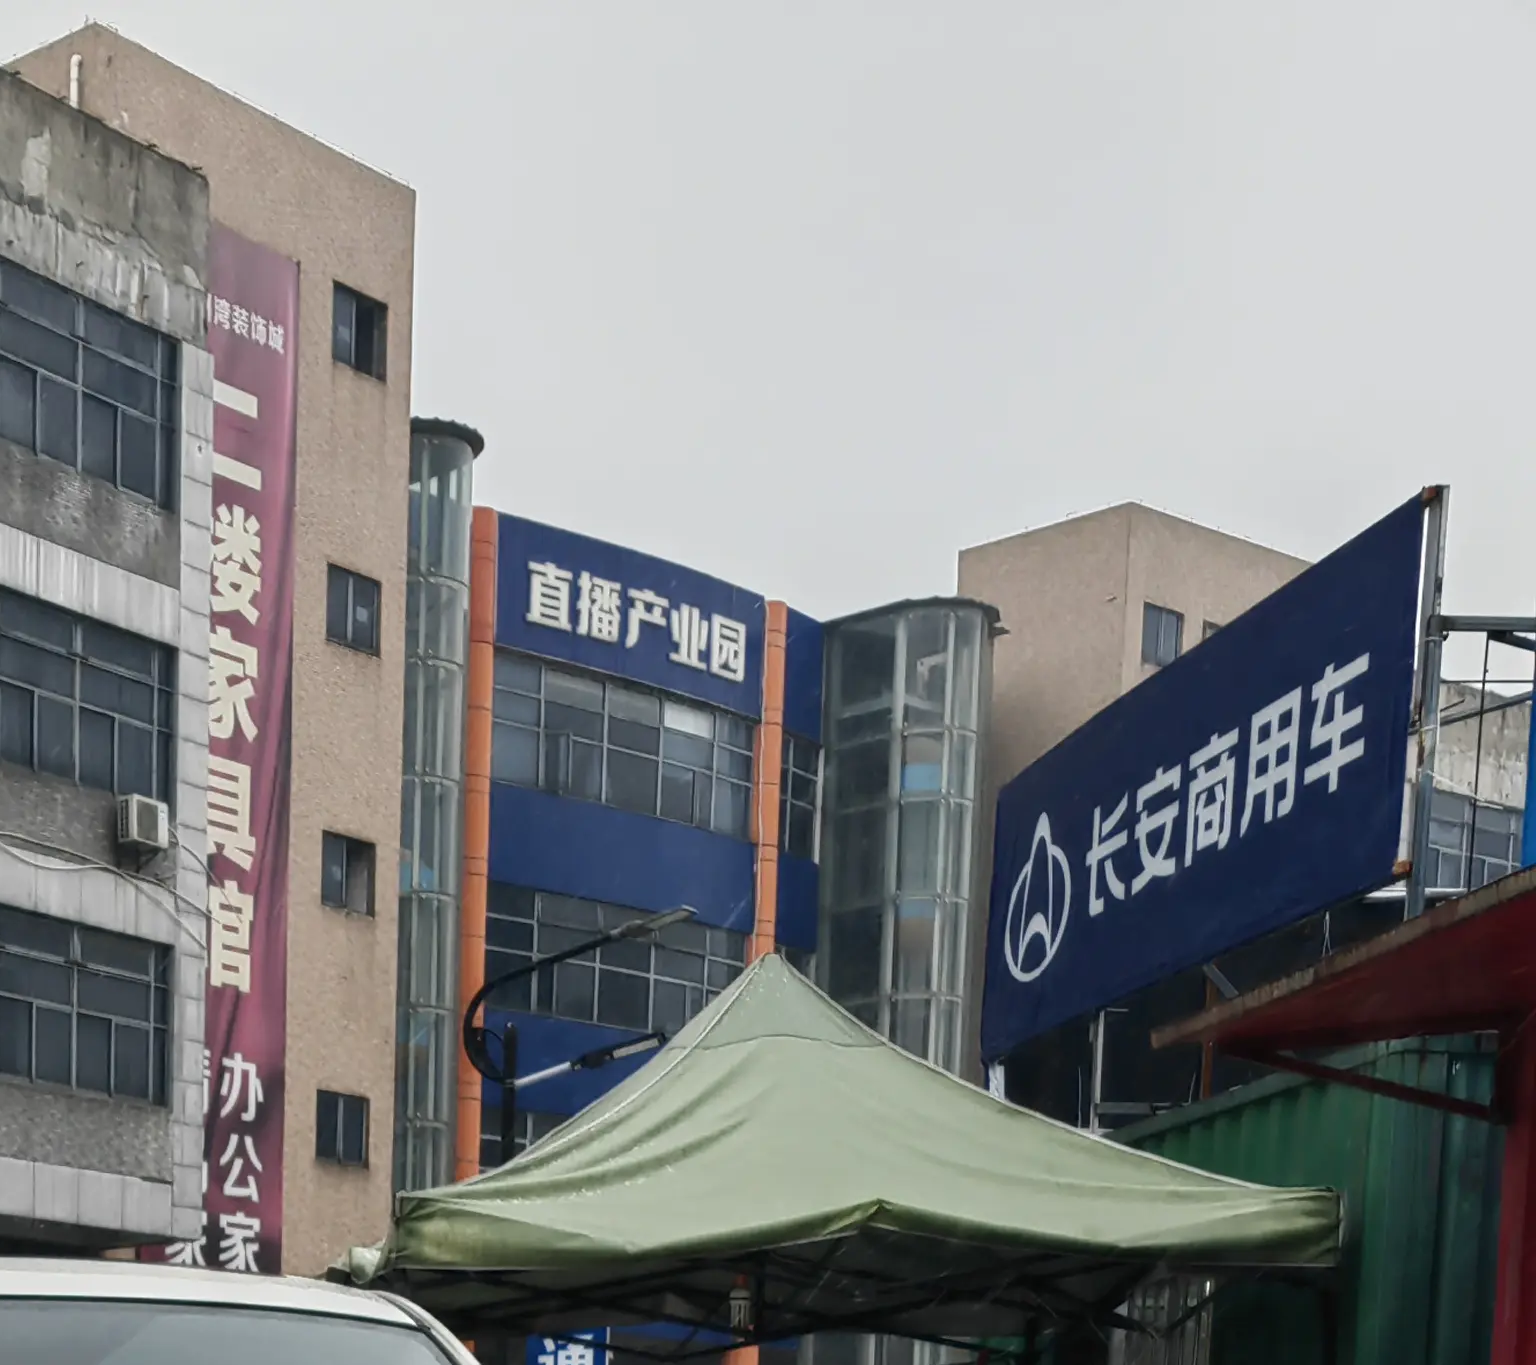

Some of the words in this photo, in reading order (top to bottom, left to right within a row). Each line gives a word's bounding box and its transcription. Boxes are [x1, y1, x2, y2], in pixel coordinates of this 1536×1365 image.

[526, 561, 747, 683] 直播产业园
[1086, 652, 1369, 917] 长安商用车
